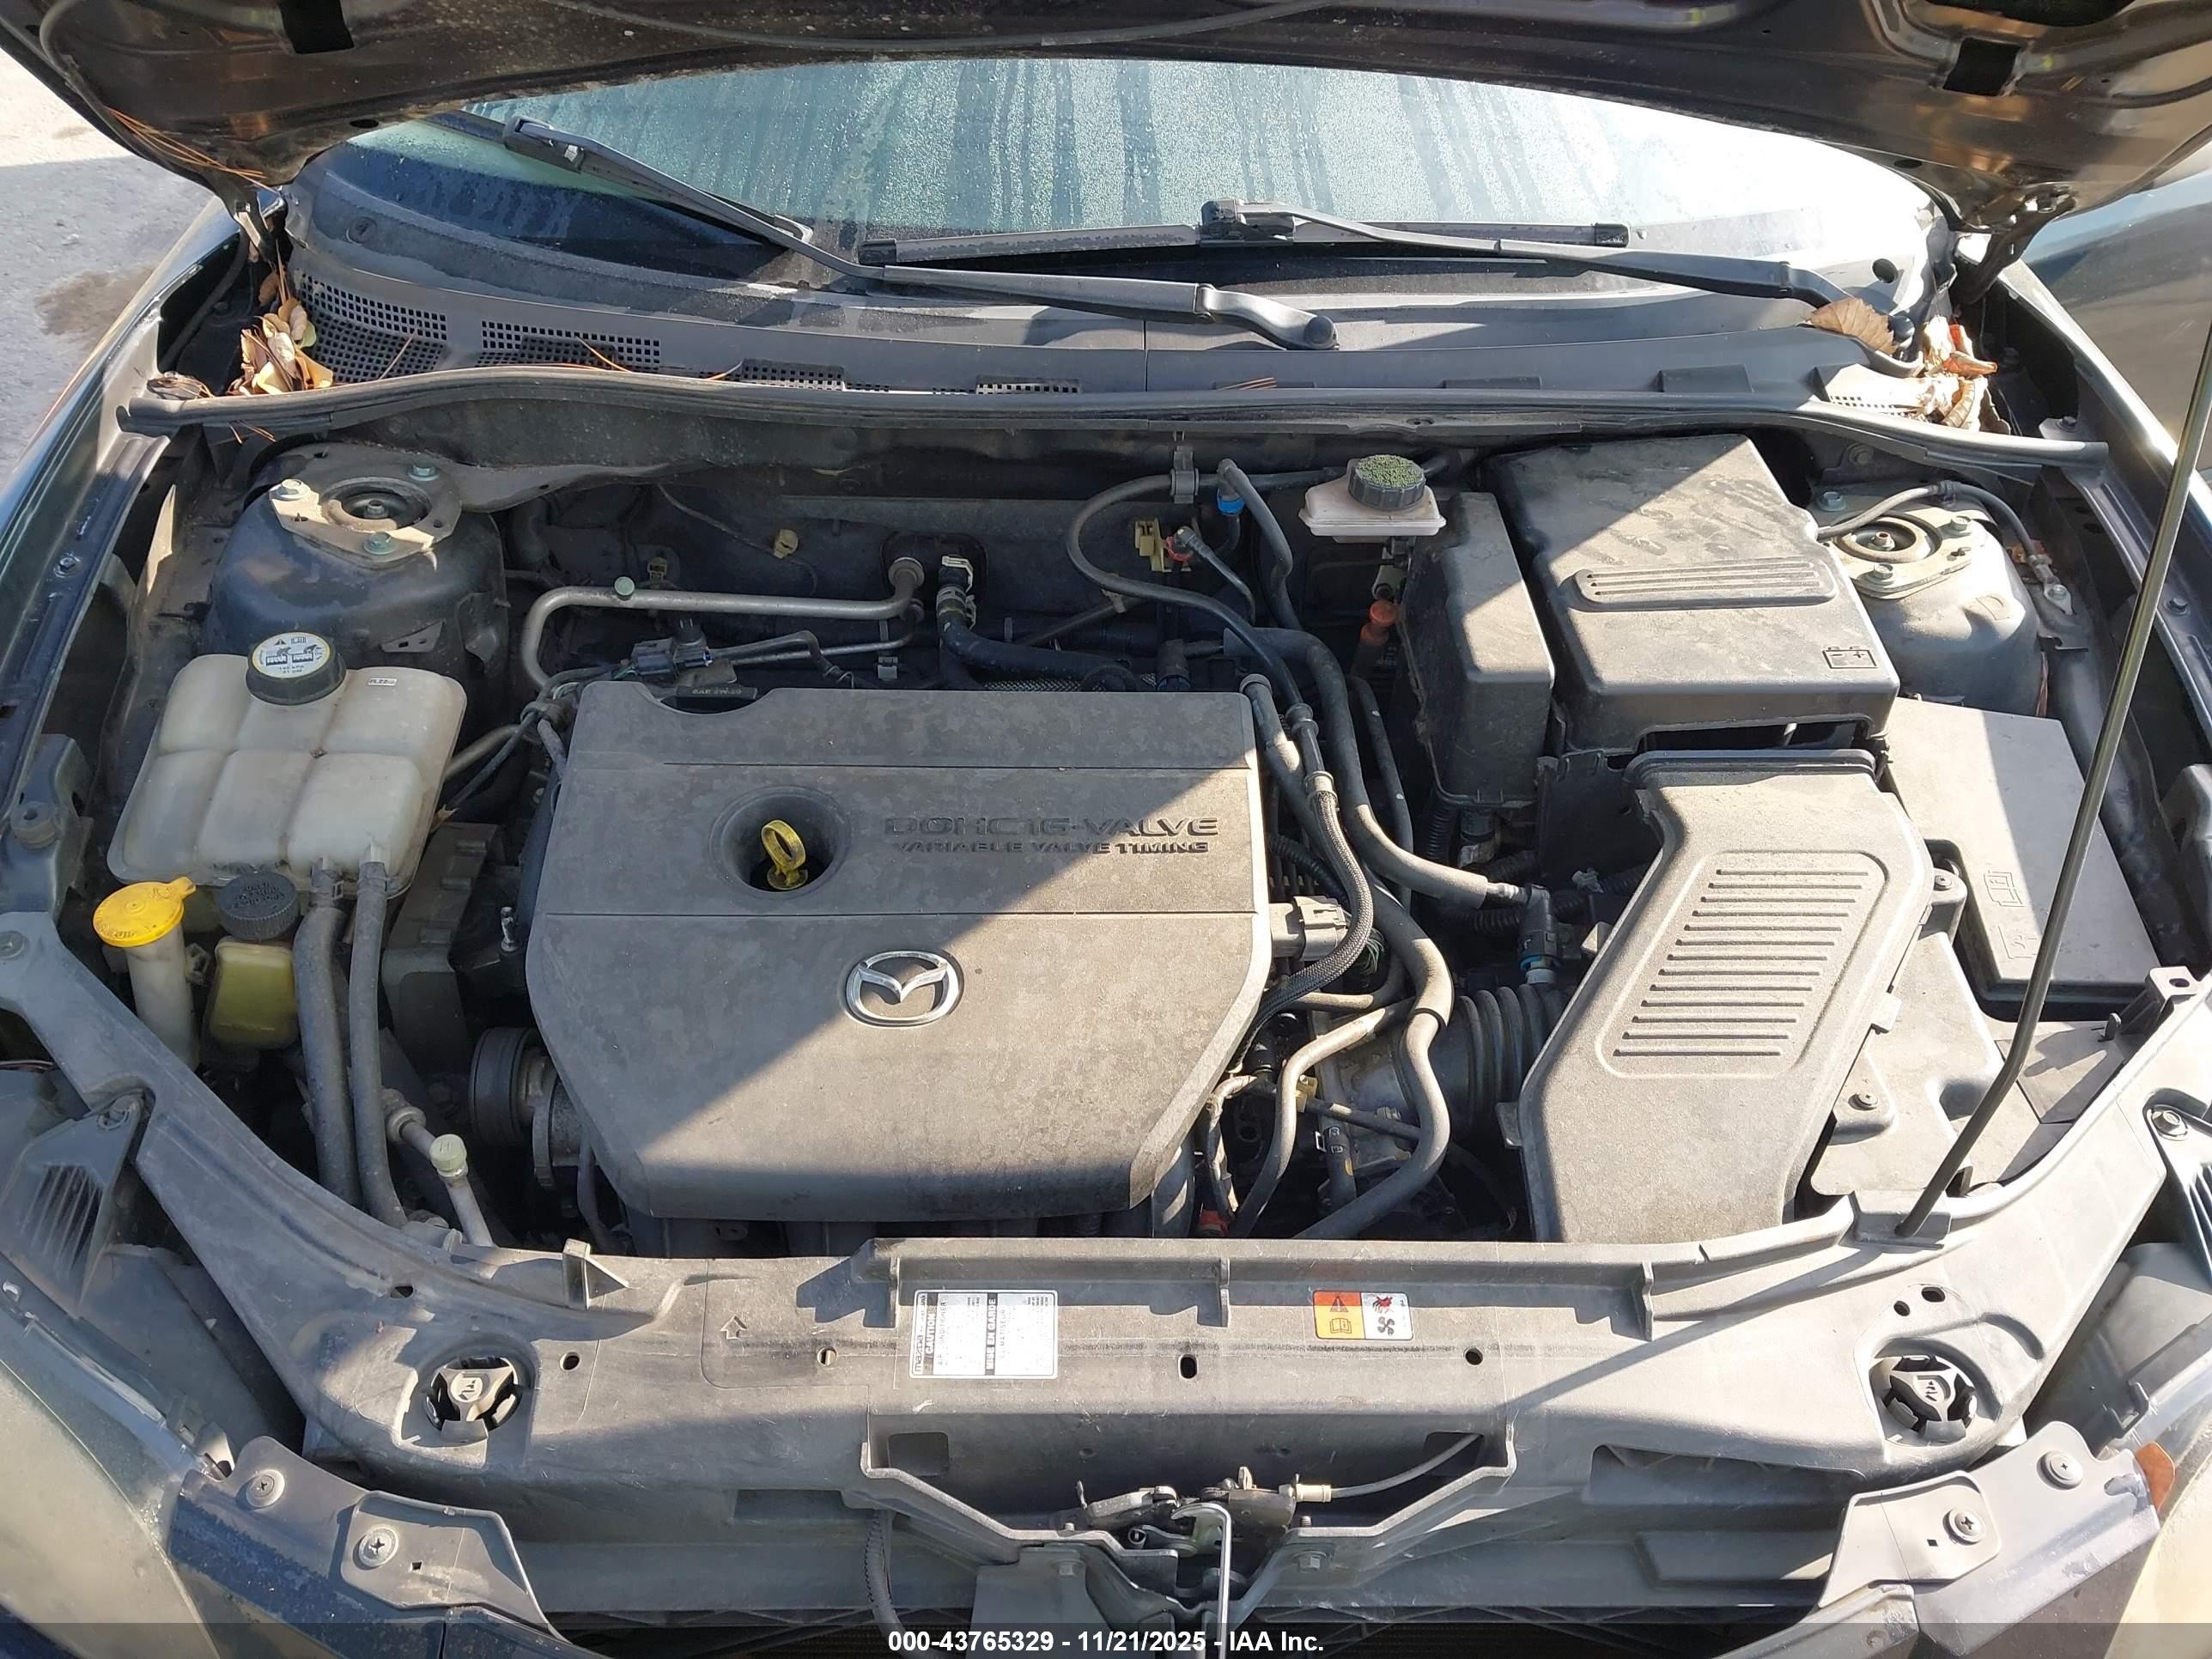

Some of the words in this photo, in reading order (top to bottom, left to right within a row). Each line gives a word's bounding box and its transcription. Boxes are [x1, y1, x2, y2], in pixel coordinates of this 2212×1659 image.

[896, 842, 1024, 854] VARIABLE
[1032, 842, 1111, 854] VALVE
[1115, 842, 1209, 854] TIMING
[988, 1298, 997, 1330] GARDE
[925, 1313, 936, 1354] CAUTION
